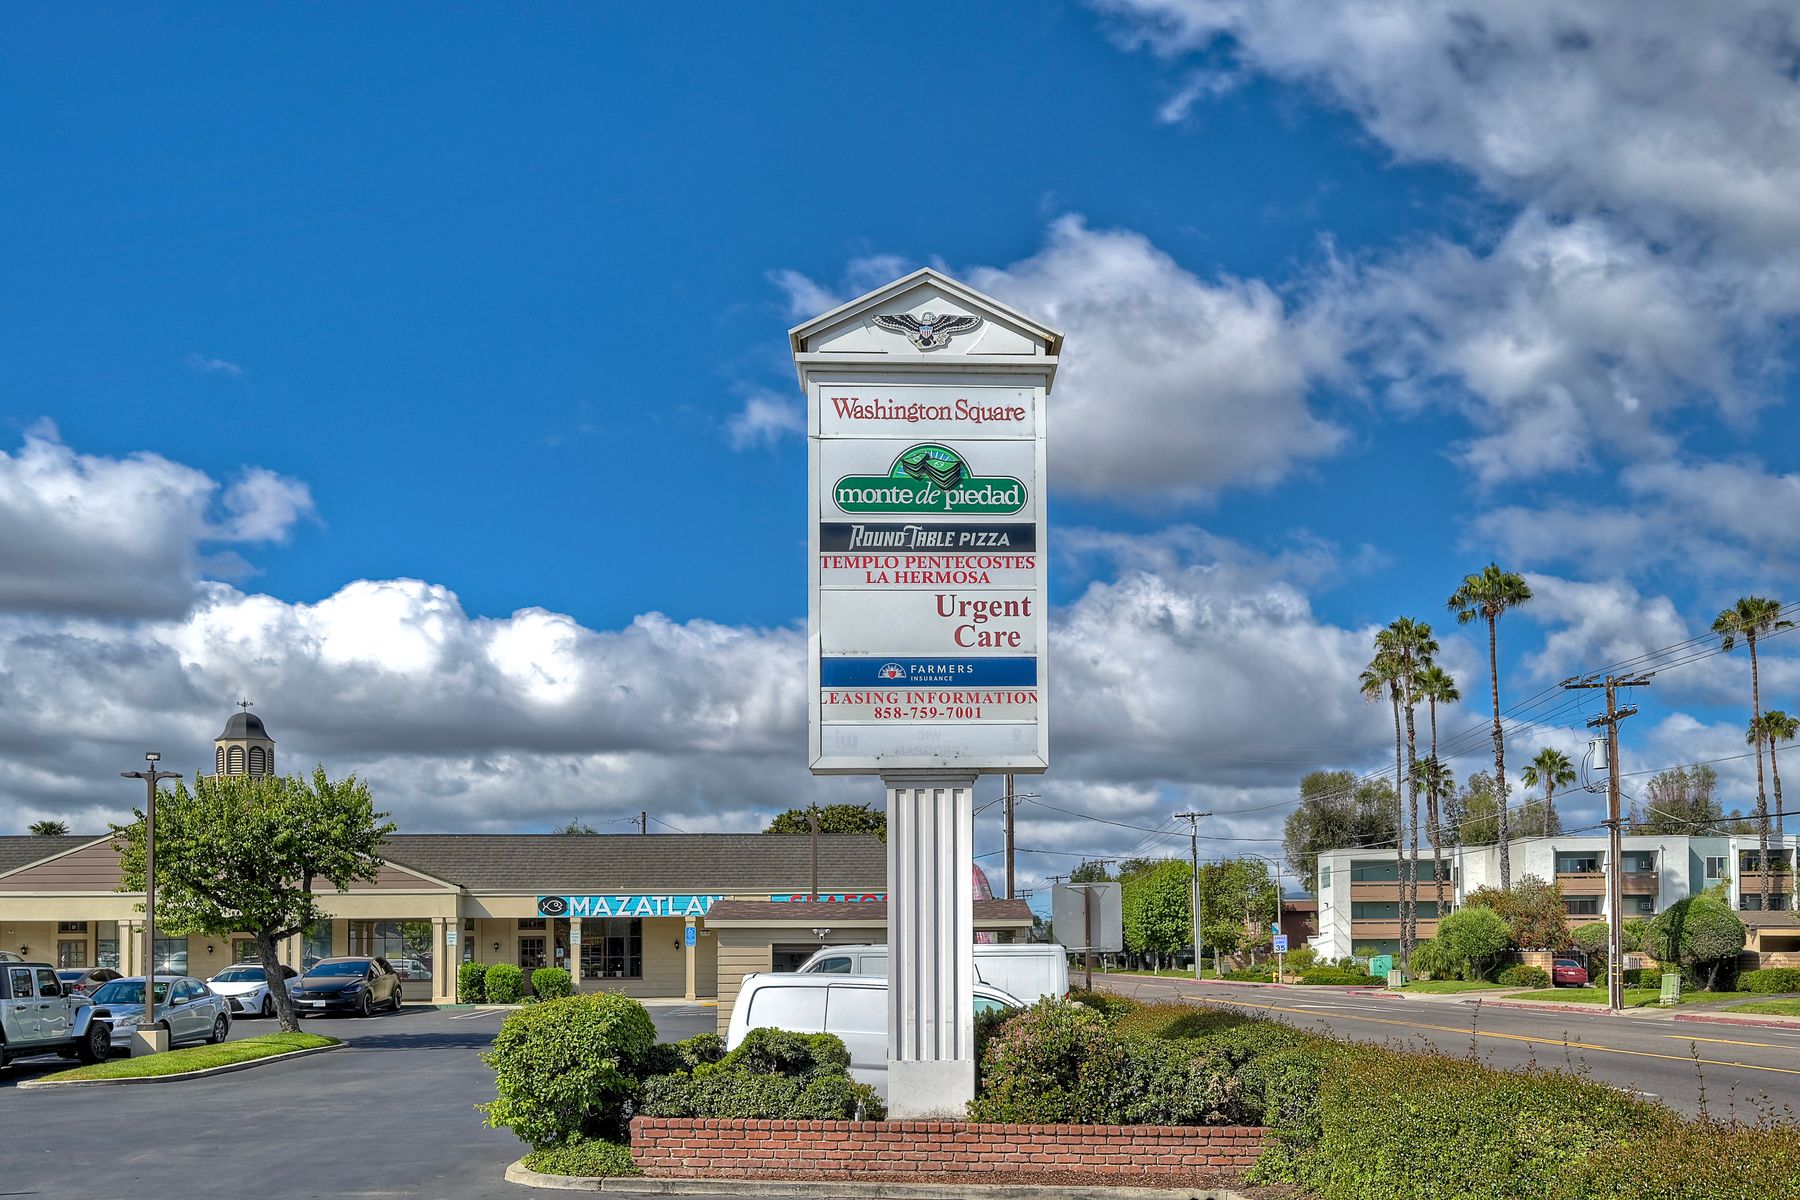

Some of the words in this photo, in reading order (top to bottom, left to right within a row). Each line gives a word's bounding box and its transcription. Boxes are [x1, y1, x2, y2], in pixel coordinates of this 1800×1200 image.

[831, 397, 952, 422] Washington
[955, 399, 1026, 423] Square
[837, 486, 913, 505] monte
[916, 481, 941, 505] de
[944, 483, 1021, 510] piedad
[959, 532, 1010, 547] PIZZA
[820, 556, 899, 569] TEMPLO
[904, 555, 1036, 569] PENTECOSTES
[866, 571, 890, 584] LA
[894, 571, 991, 584] HERMOSA
[935, 594, 1032, 624] Urgent
[954, 624, 1022, 648] Care
[910, 664, 974, 674] FARMERS
[906, 692, 1037, 704] INFORMATION
[874, 706, 982, 719] 858-759-7001
